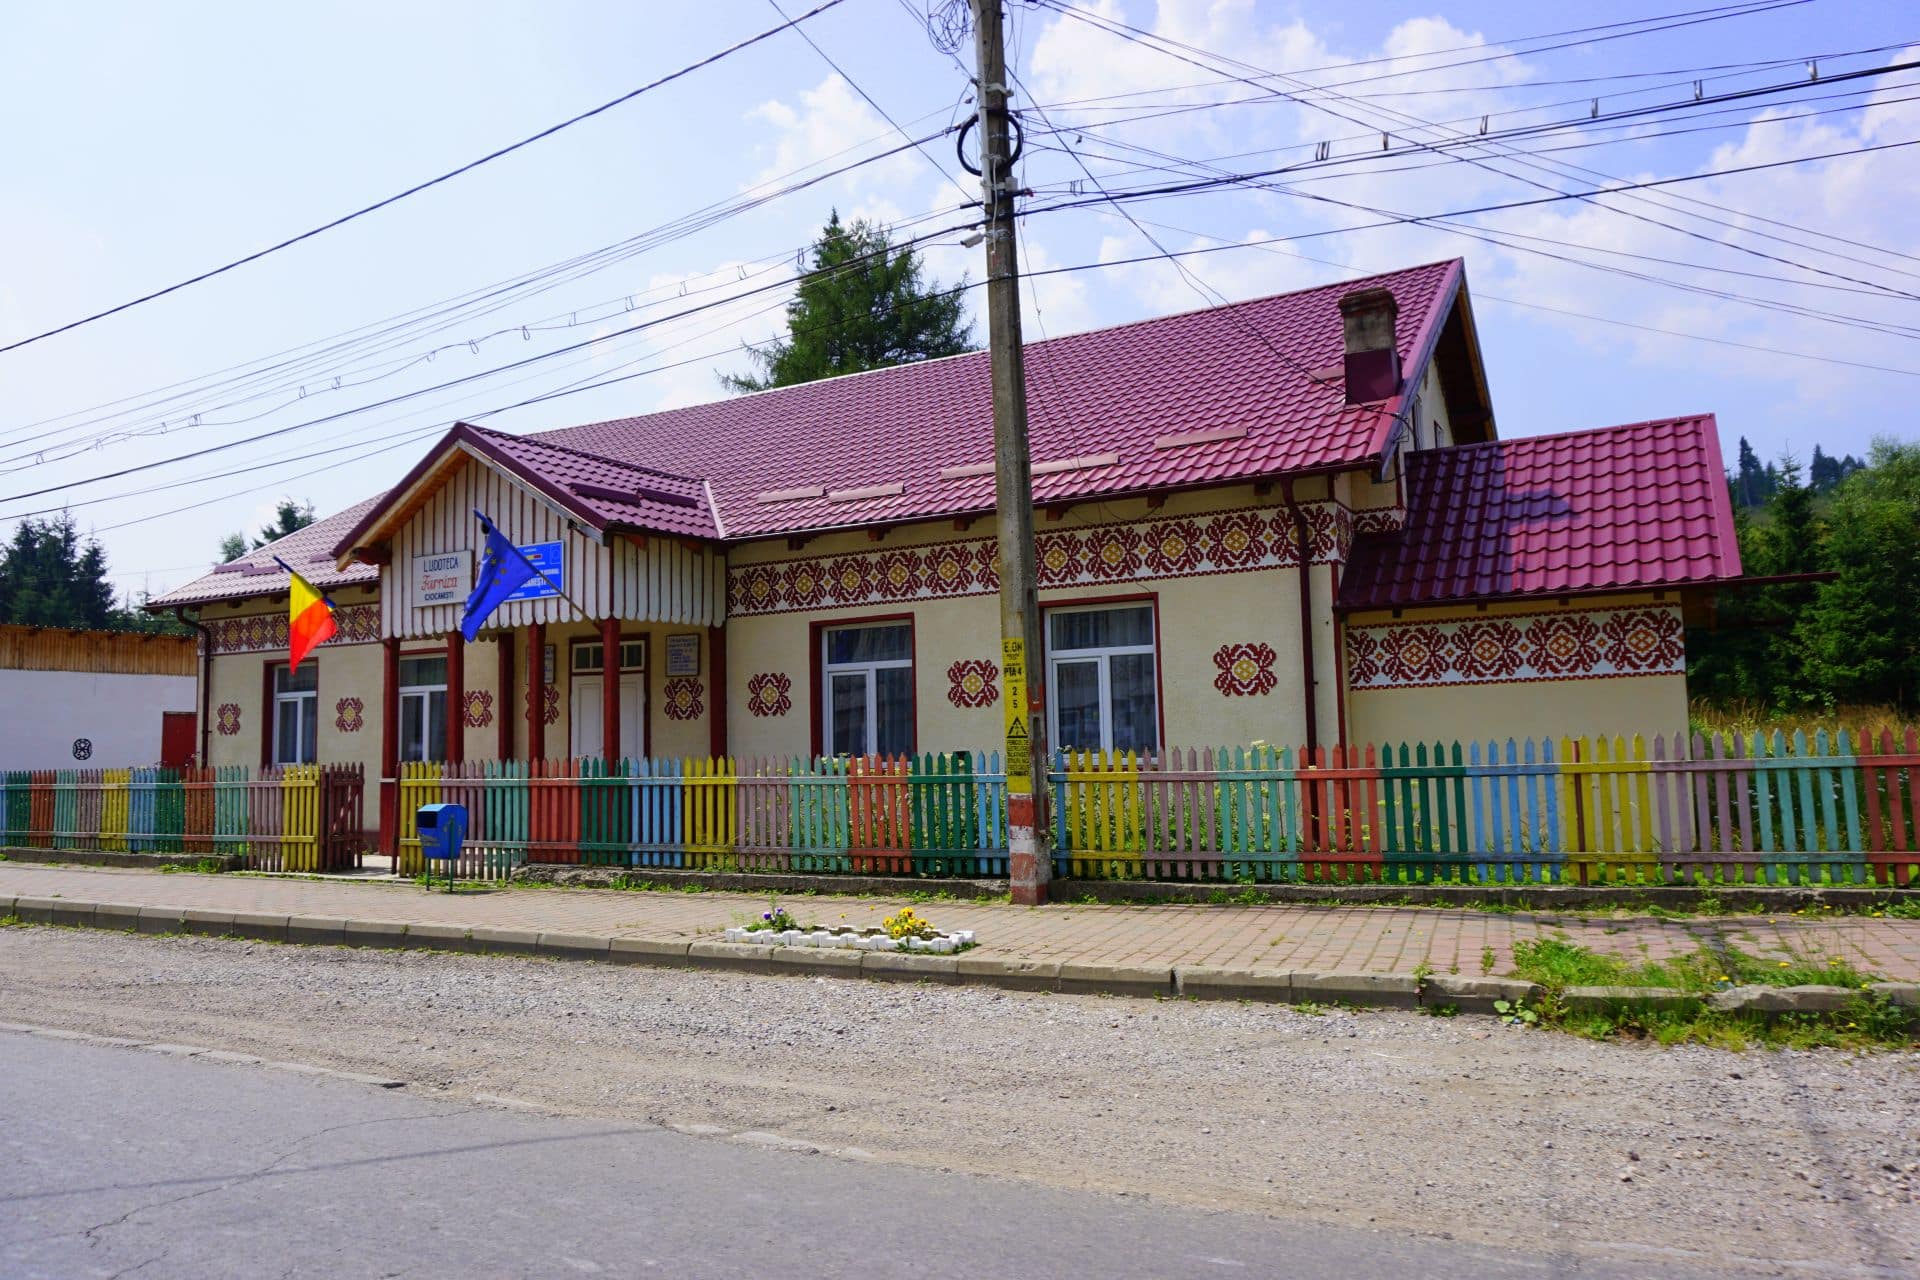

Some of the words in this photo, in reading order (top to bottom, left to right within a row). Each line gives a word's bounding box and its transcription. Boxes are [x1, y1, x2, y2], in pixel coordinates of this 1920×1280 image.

[423, 556, 459, 573] LUDOTECA
[1012, 686, 1018, 696] 2
[1012, 699, 1018, 709] 5
